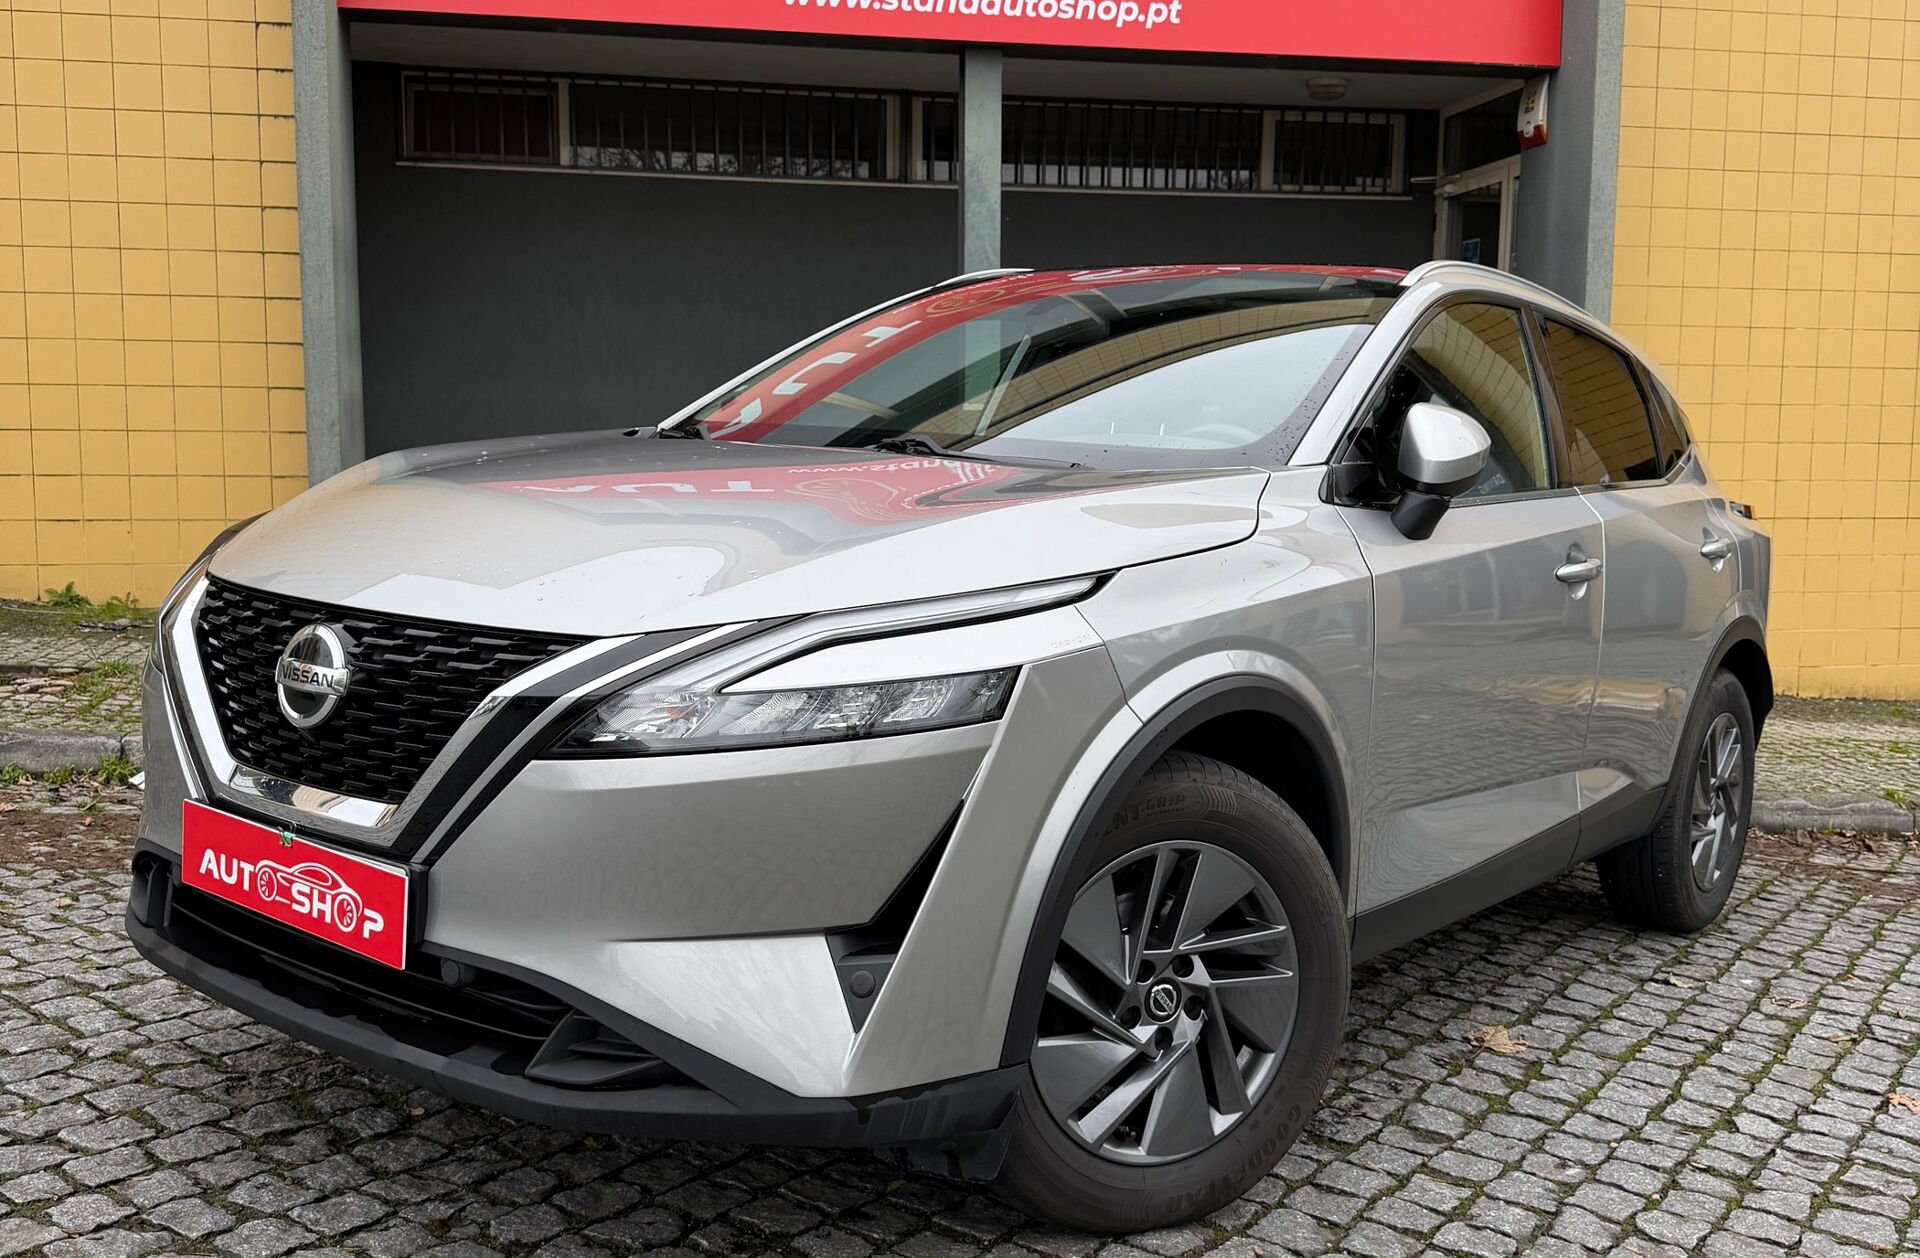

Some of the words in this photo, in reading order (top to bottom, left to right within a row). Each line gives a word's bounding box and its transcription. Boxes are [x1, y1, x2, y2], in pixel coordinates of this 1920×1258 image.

[280, 664, 334, 688] NISSAN
[199, 847, 277, 902] AUTO
[290, 882, 385, 939] SHOP
